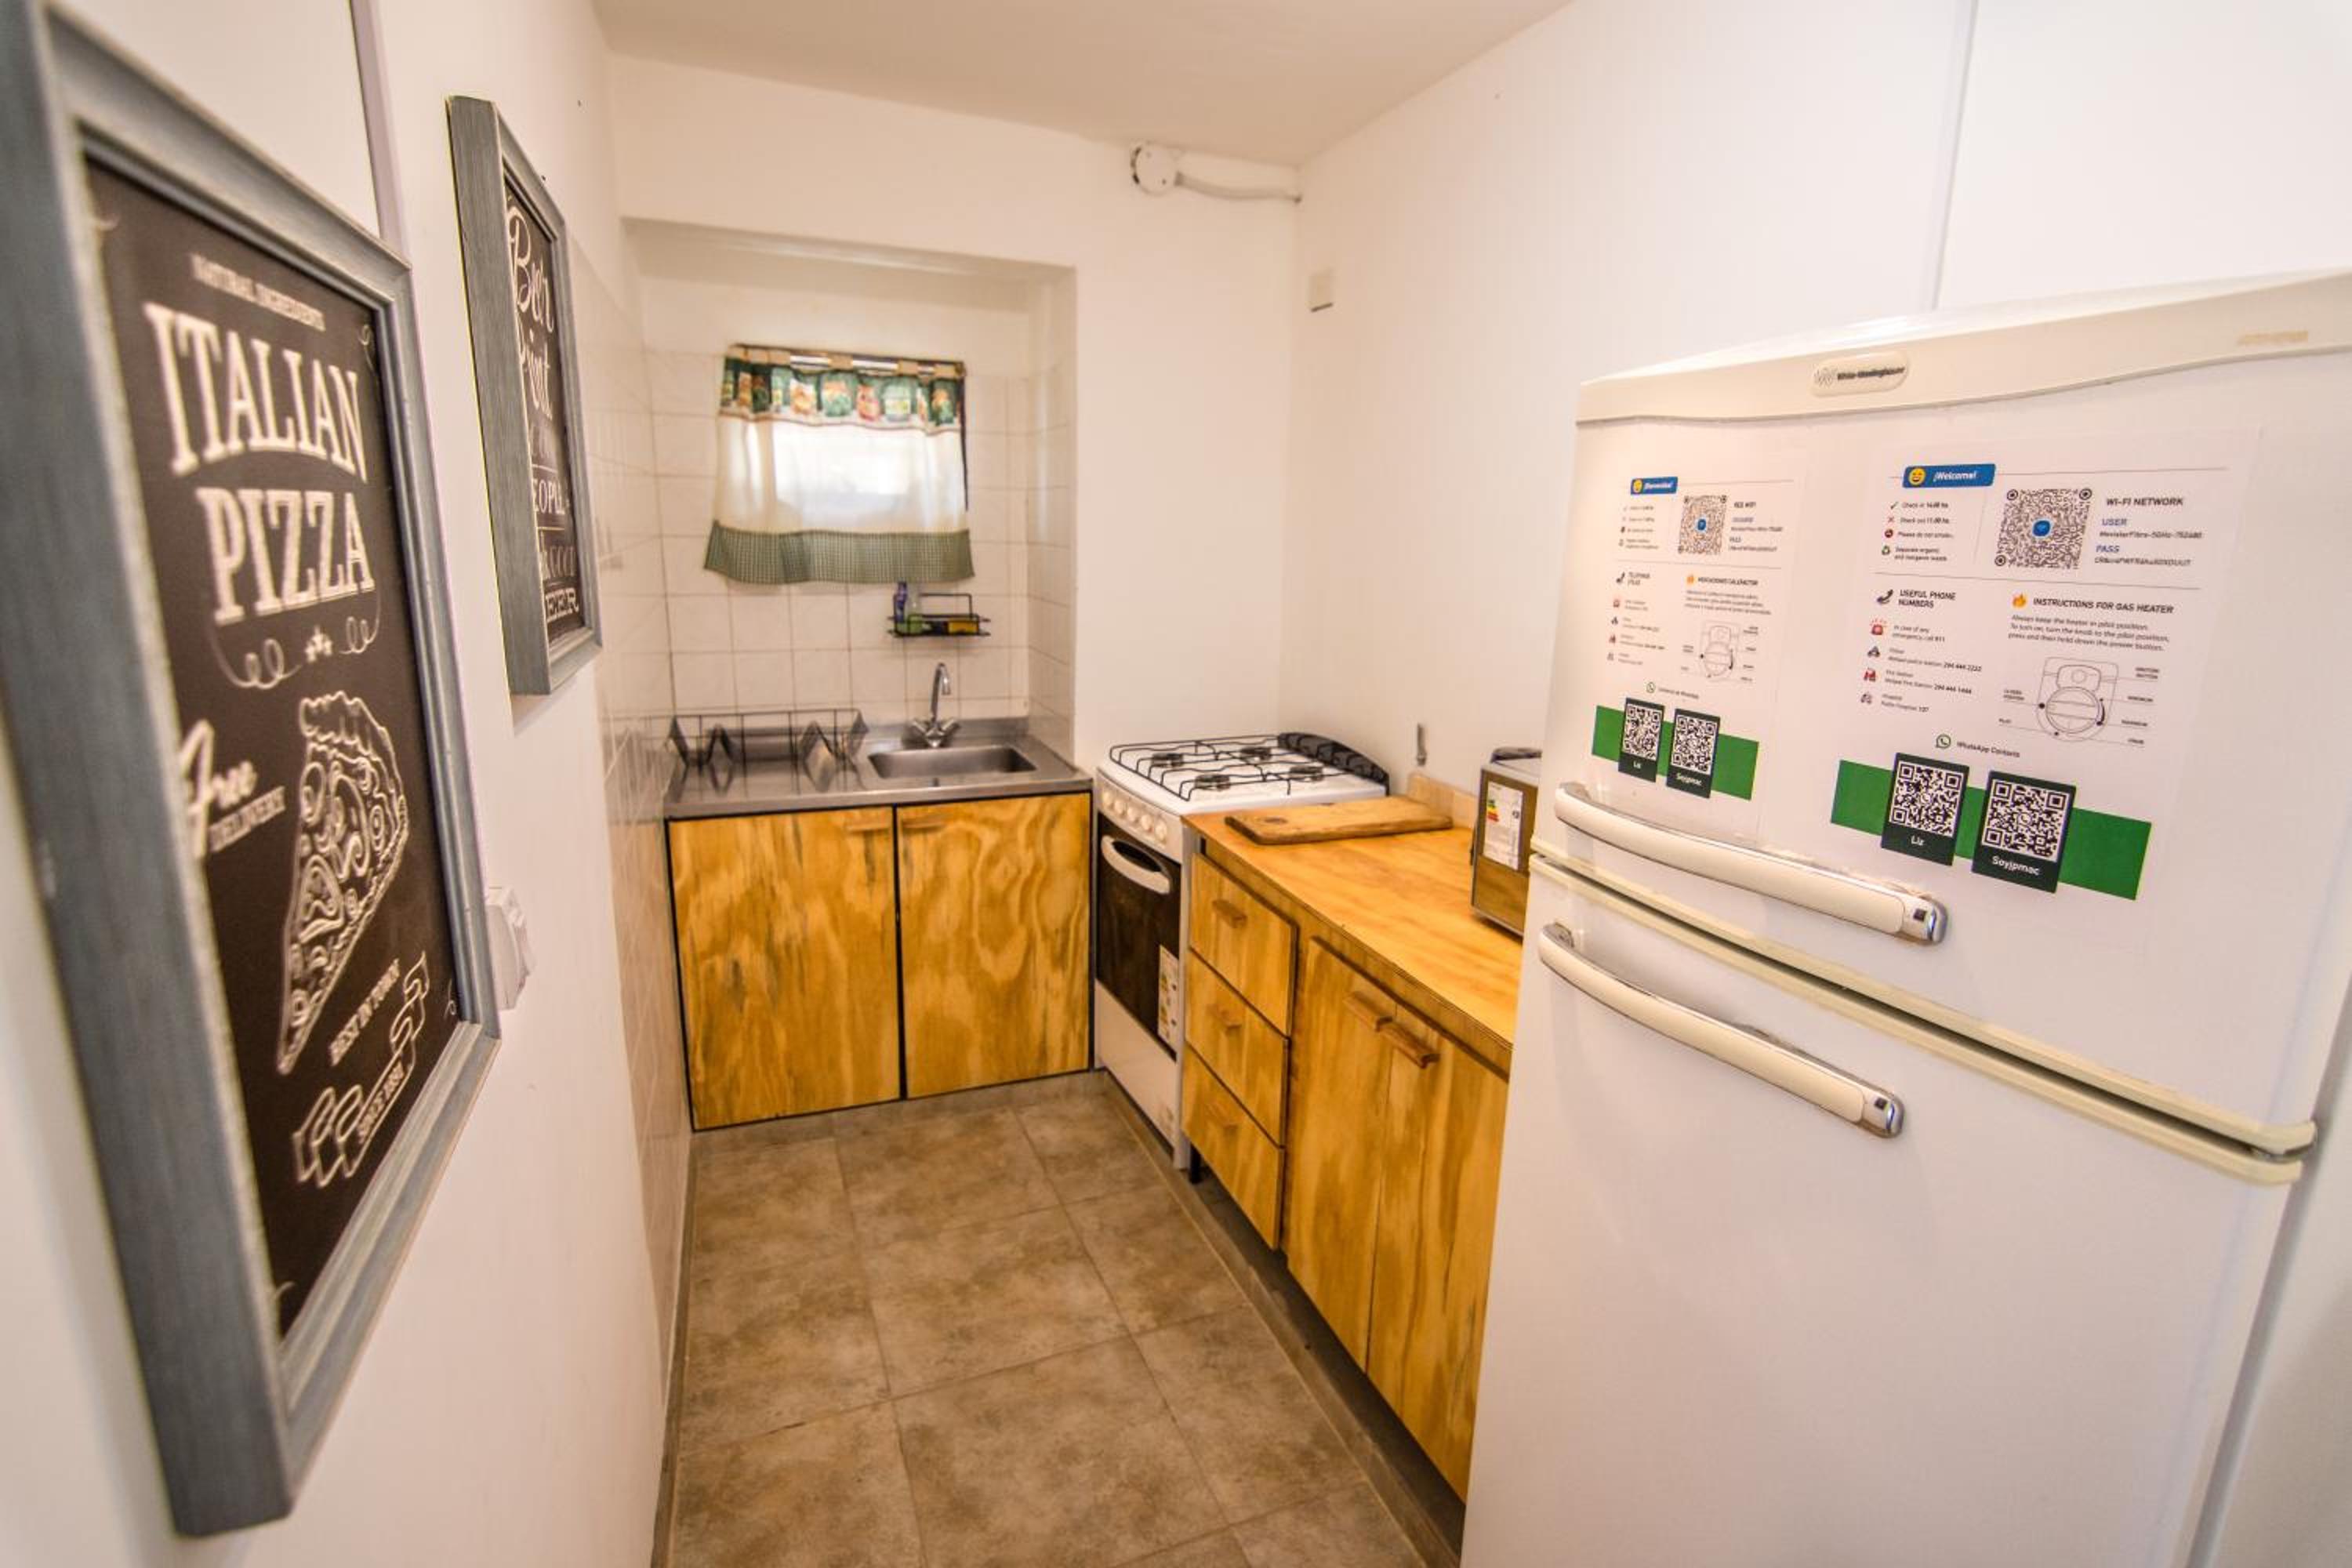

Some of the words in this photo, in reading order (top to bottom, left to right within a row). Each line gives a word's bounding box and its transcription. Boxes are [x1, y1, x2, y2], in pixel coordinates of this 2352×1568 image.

[142, 303, 369, 482] ITALIAN
[2133, 498, 2183, 506] NETWORK
[196, 485, 376, 626] PIZZA
[1898, 598, 1934, 608] NUMBERS
[1900, 589, 1928, 599] USEFUL
[1929, 590, 1956, 601] PHONE
[545, 586, 579, 623] EER
[2033, 597, 2094, 609] INSTRUCTIONS
[2096, 601, 2114, 610] FOR
[2116, 602, 2134, 612] GAS
[2136, 604, 2174, 614] HEATER
[2011, 614, 2034, 623] Always
[2034, 615, 2051, 625] keep
[2053, 616, 2065, 625] the
[2066, 618, 2088, 626] heater
[2097, 620, 2114, 630] pilot
[2008, 633, 2025, 642] press
[2057, 636, 2074, 644] hold
[2074, 637, 2096, 645] down
[2096, 638, 2108, 647] the
[2074, 628, 2092, 637] knob
[2116, 631, 2134, 641] pilot
[1957, 741, 1990, 755] WhatsApp
[1991, 745, 2021, 759] Contacts
[209, 785, 287, 853] DELIVERY
[1911, 834, 1925, 847] Liz
[1991, 855, 2040, 877] Soyjpmac
